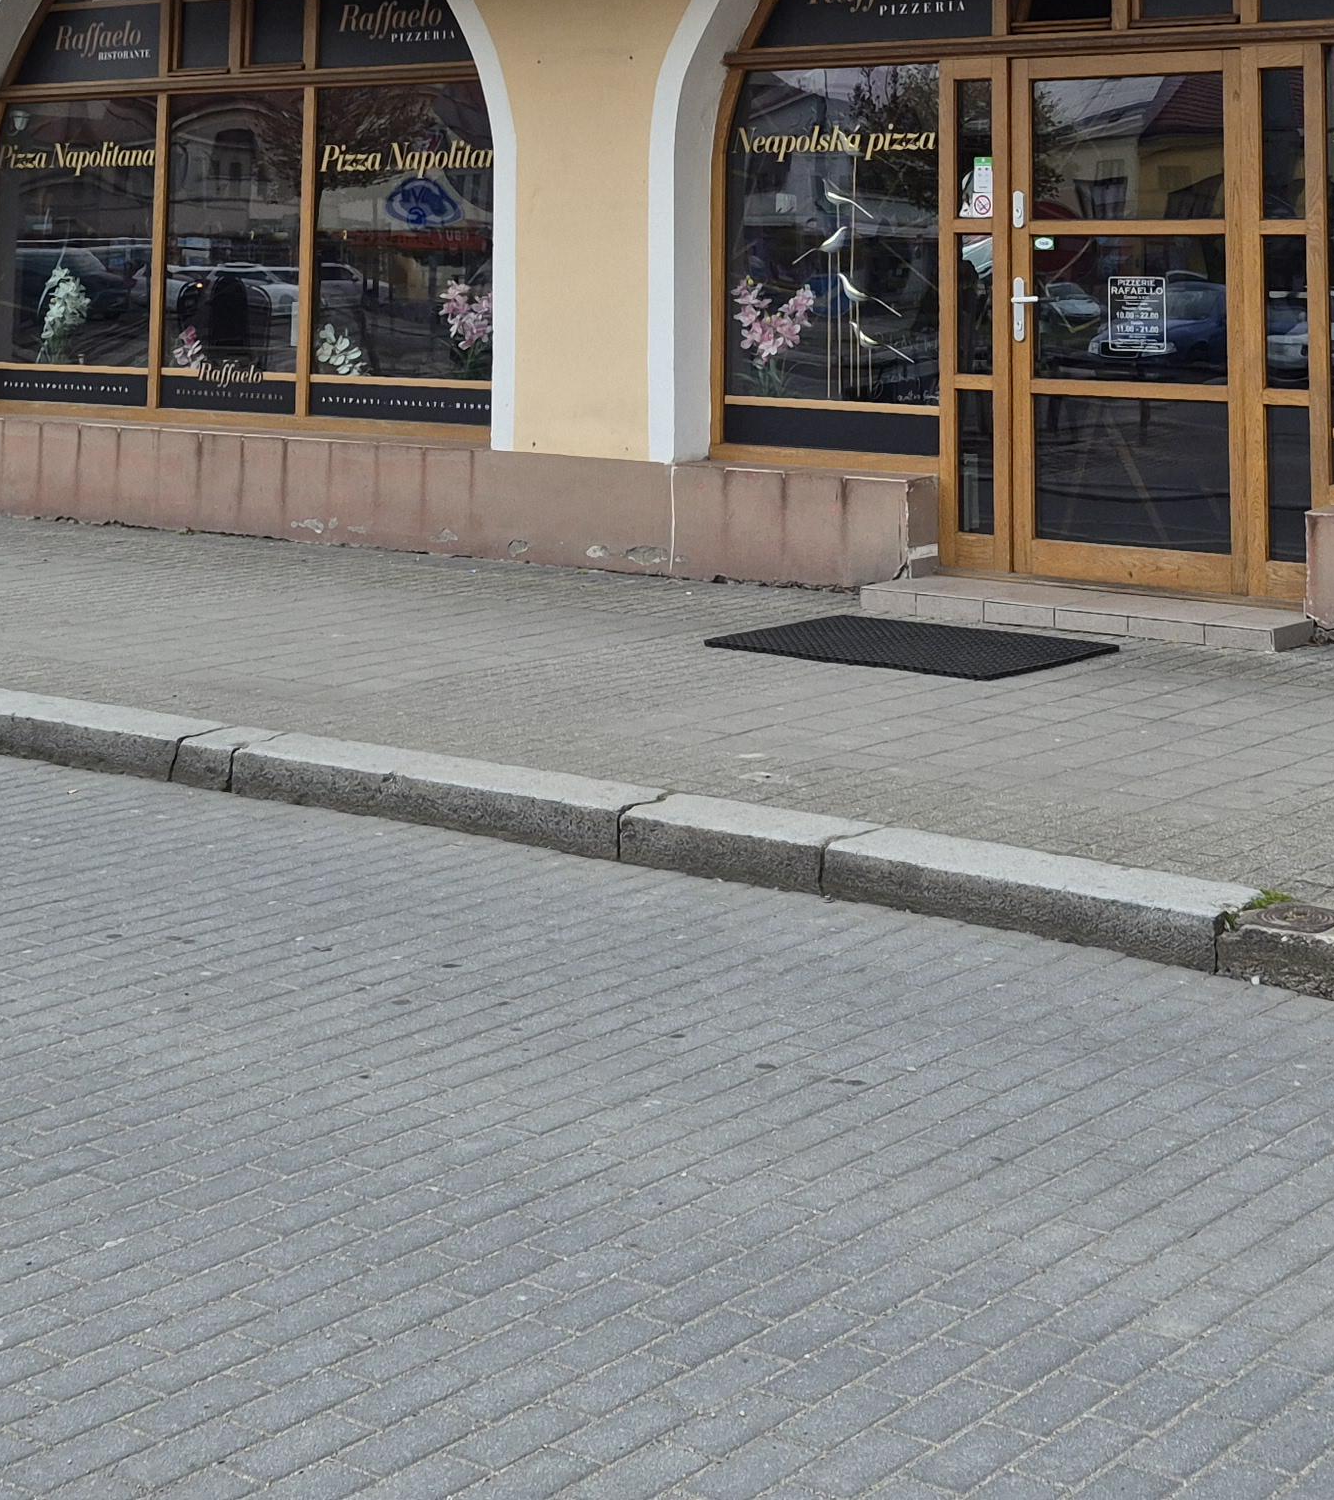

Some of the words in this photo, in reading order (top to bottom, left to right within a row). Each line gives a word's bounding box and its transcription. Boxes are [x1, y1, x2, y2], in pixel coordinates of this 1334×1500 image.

[339, 0, 442, 40] Raffaelo
[879, 0, 965, 16] PIZZERIA
[55, 20, 141, 58] Raffaelo
[391, 30, 455, 43] PIZZERIA
[98, 49, 151, 61] RISTORANTE
[733, 125, 861, 162] Neapolská
[865, 124, 936, 161] pizza
[49, 141, 156, 177] Napolitana
[320, 144, 381, 172] Pizza
[1111, 286, 1164, 295] RAFAELLO
[199, 362, 262, 388] Raffaelo
